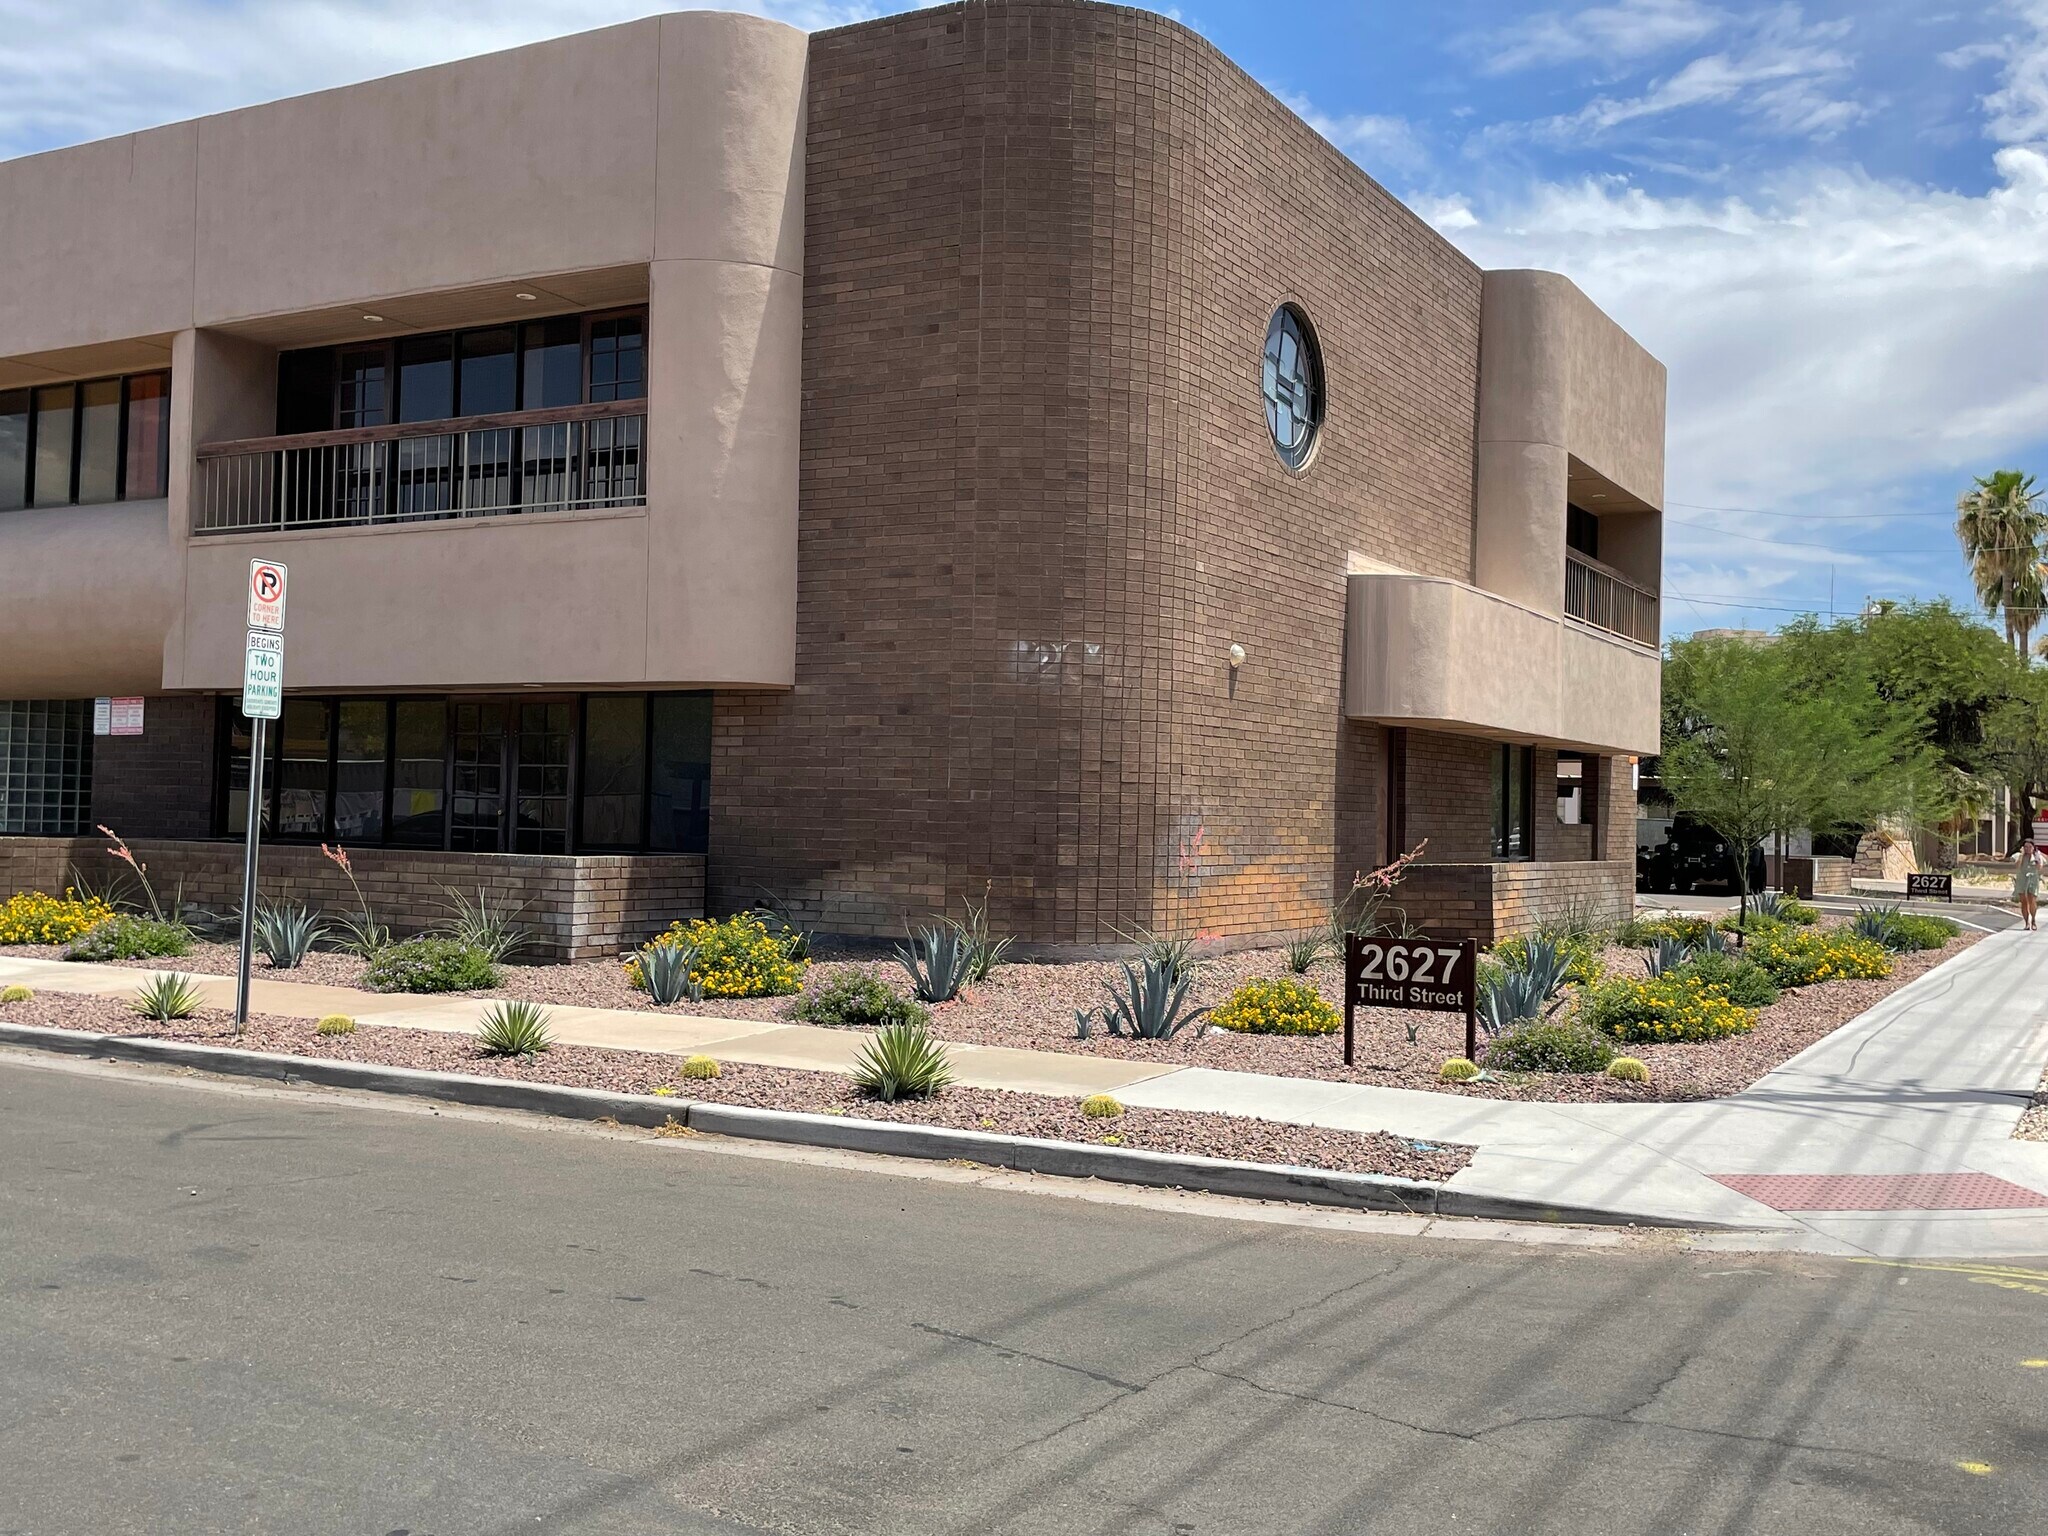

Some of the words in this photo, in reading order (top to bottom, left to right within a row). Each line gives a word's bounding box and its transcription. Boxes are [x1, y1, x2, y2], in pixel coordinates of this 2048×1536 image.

[253, 603, 280, 614] CORNER
[252, 612, 261, 622] TO
[262, 614, 280, 625] HERE
[250, 636, 280, 650] BEGINS
[254, 654, 275, 667] TWO
[250, 669, 277, 682] HOUR
[247, 683, 278, 698] PARKING
[1911, 876, 1947, 888] 2627
[1360, 943, 1462, 984] 2627
[1357, 983, 1404, 1001] Third
[1409, 986, 1463, 1006] Street
